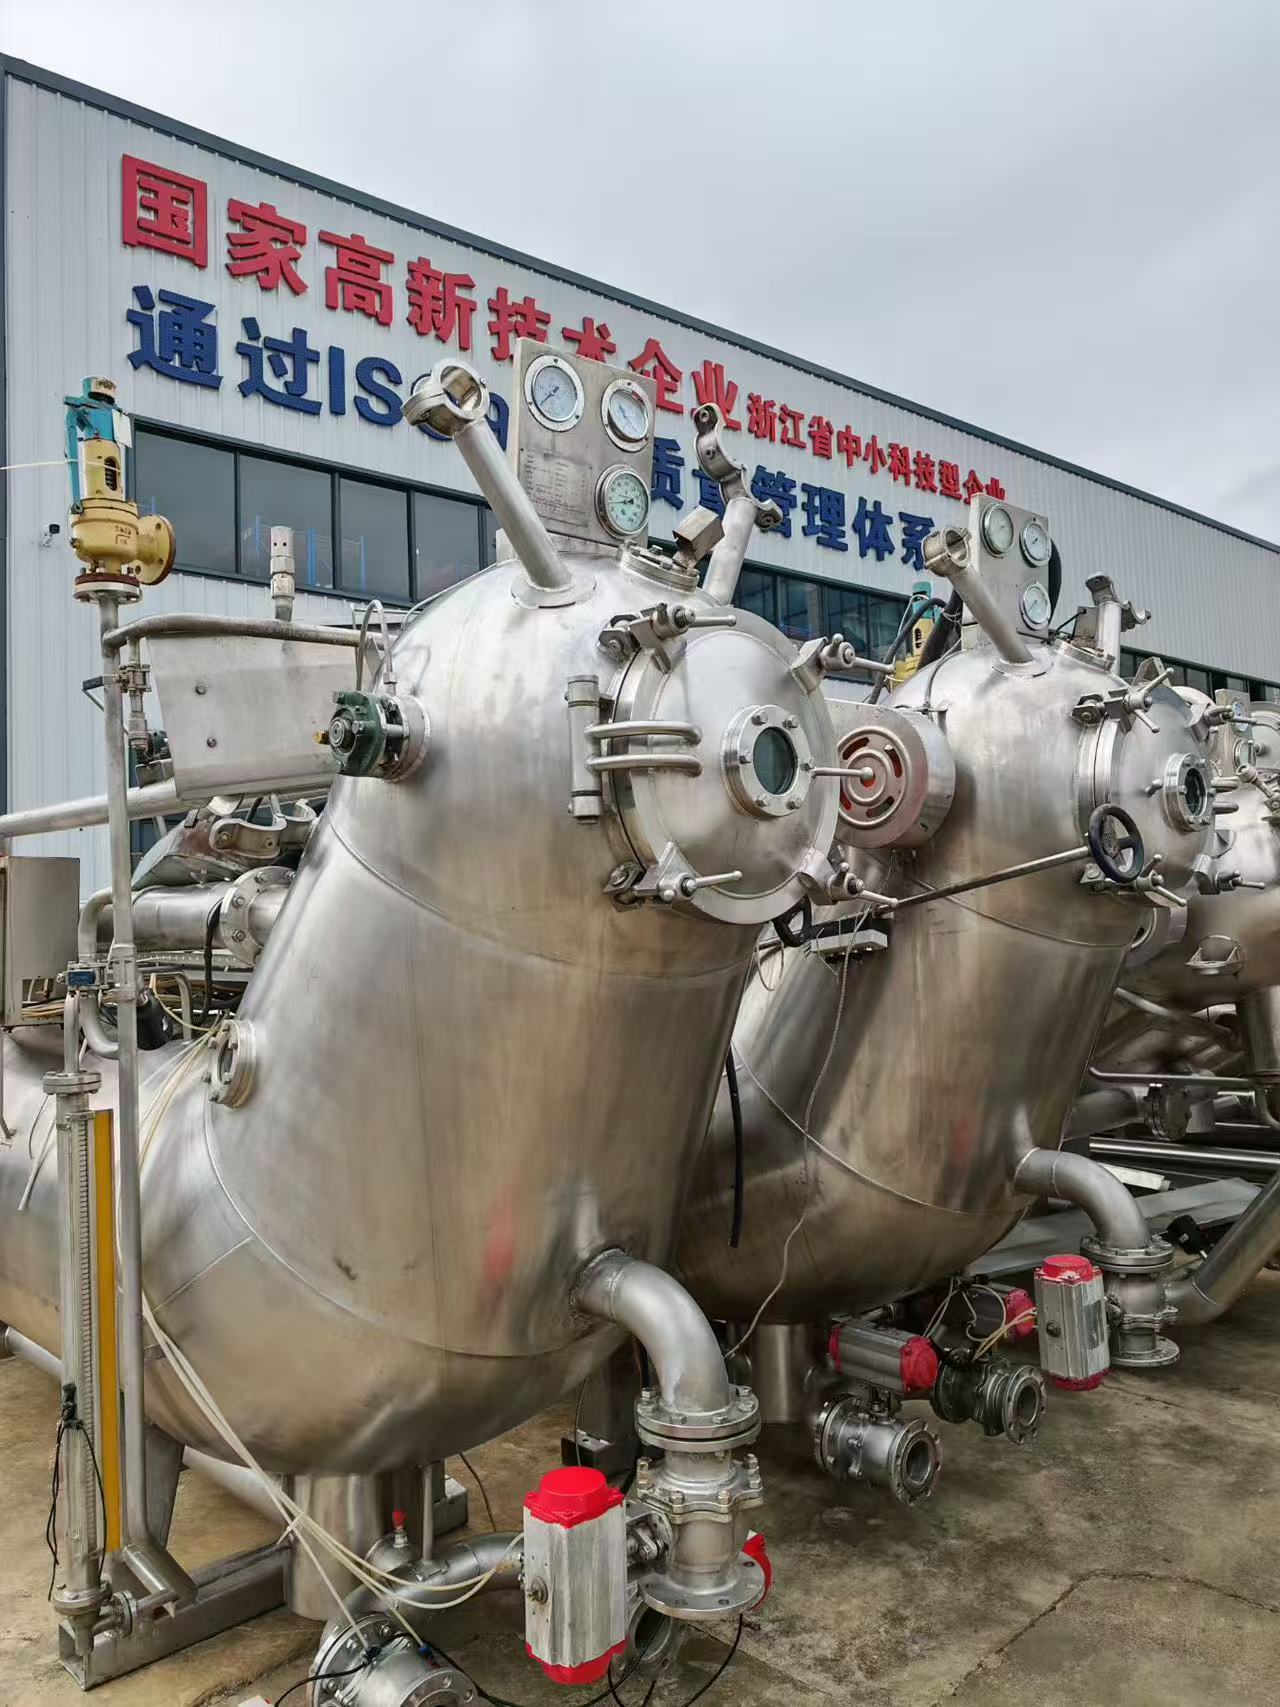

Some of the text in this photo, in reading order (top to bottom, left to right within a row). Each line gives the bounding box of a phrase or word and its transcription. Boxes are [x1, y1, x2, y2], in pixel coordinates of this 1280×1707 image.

[122, 154, 742, 431] 国家高新技术企业
[747, 393, 1006, 505] 浙江省中小科技型企业
